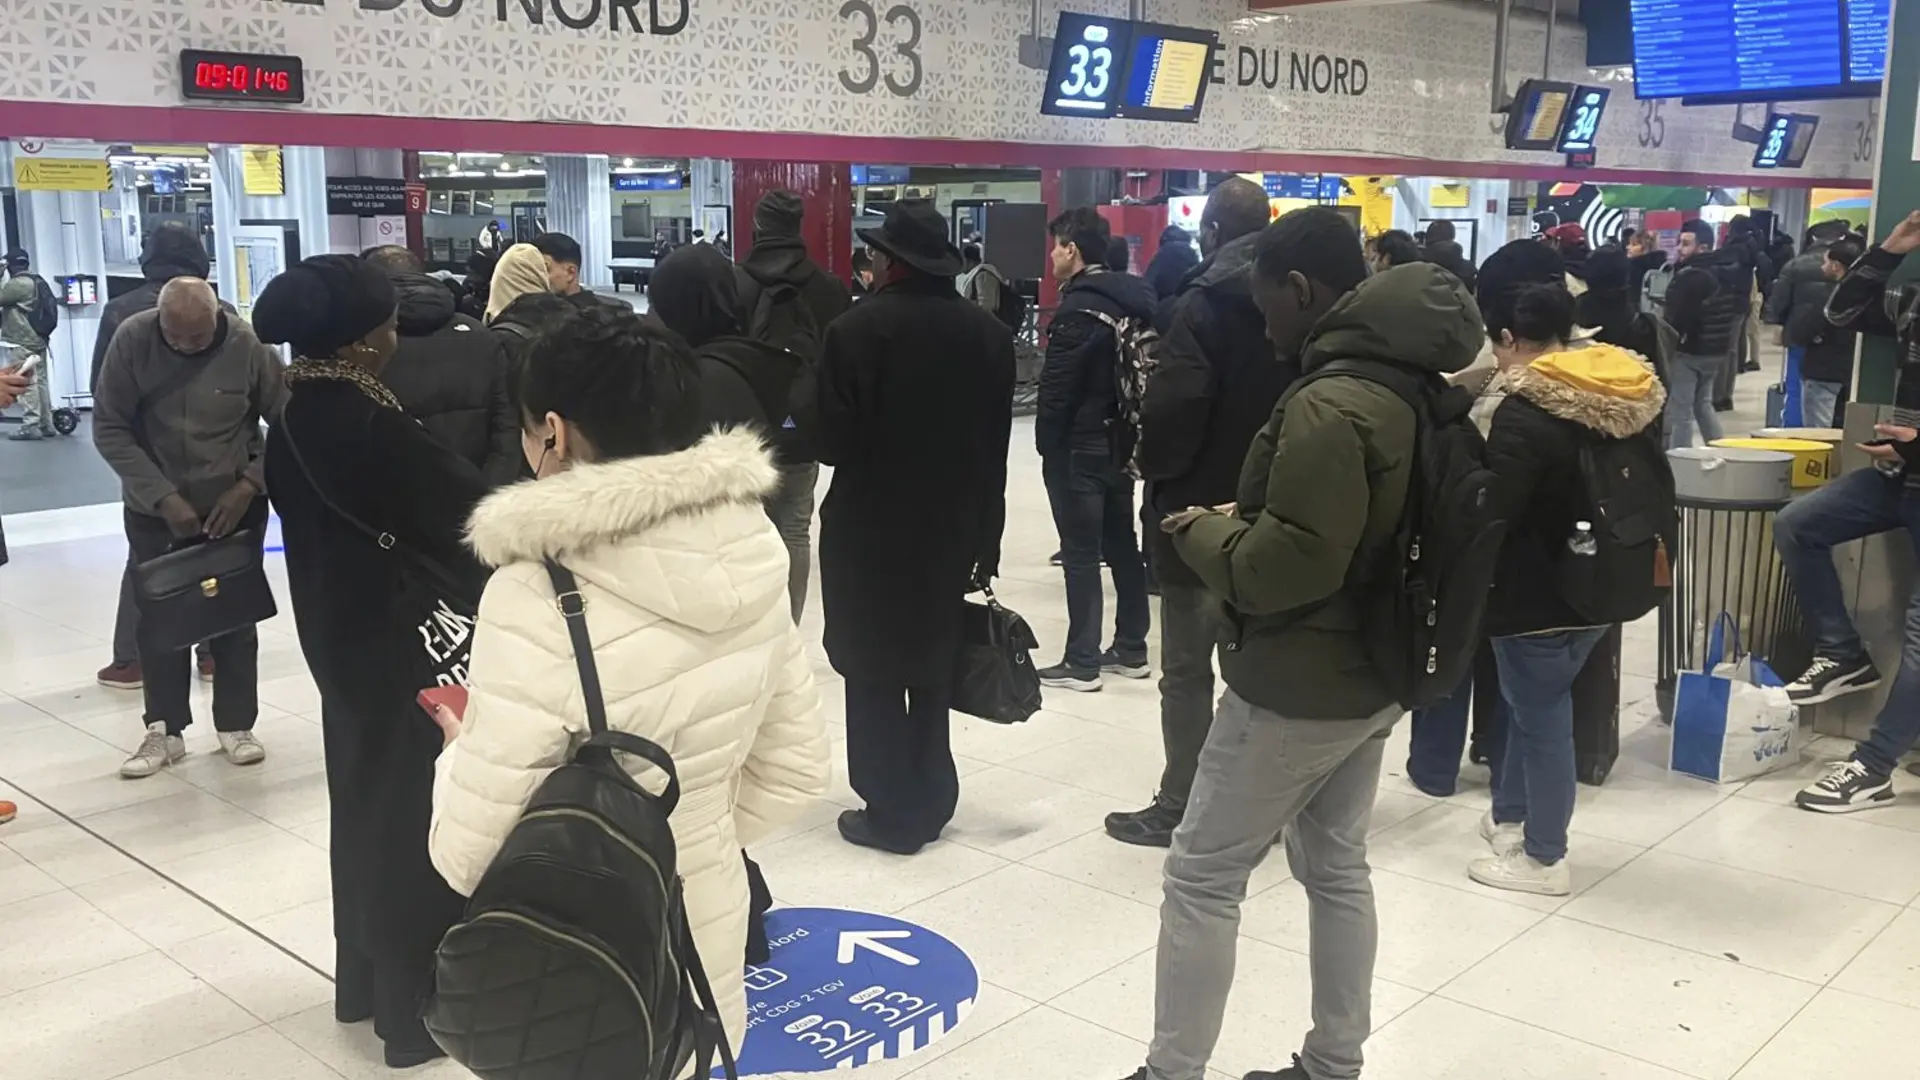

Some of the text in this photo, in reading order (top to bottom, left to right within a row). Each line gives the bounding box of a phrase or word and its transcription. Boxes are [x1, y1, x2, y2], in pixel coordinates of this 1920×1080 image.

[838, 0, 922, 97] 33
[196, 63, 289, 91] 09:01 46
[1060, 44, 1112, 98] 33
[1142, 39, 1164, 107] Information
[1237, 45, 1279, 89] DU
[1290, 51, 1368, 96] NORD
[1568, 106, 1599, 140] 34
[1638, 99, 1665, 148] 35
[1762, 129, 1786, 158] 35
[412, 197, 420, 209] 9
[768, 927, 809, 950] Nord
[765, 1000, 801, 1017] CDG
[800, 993, 815, 1002] 2
[812, 979, 845, 995] TGV
[861, 991, 924, 1022] 33
[796, 1020, 867, 1053] 32
